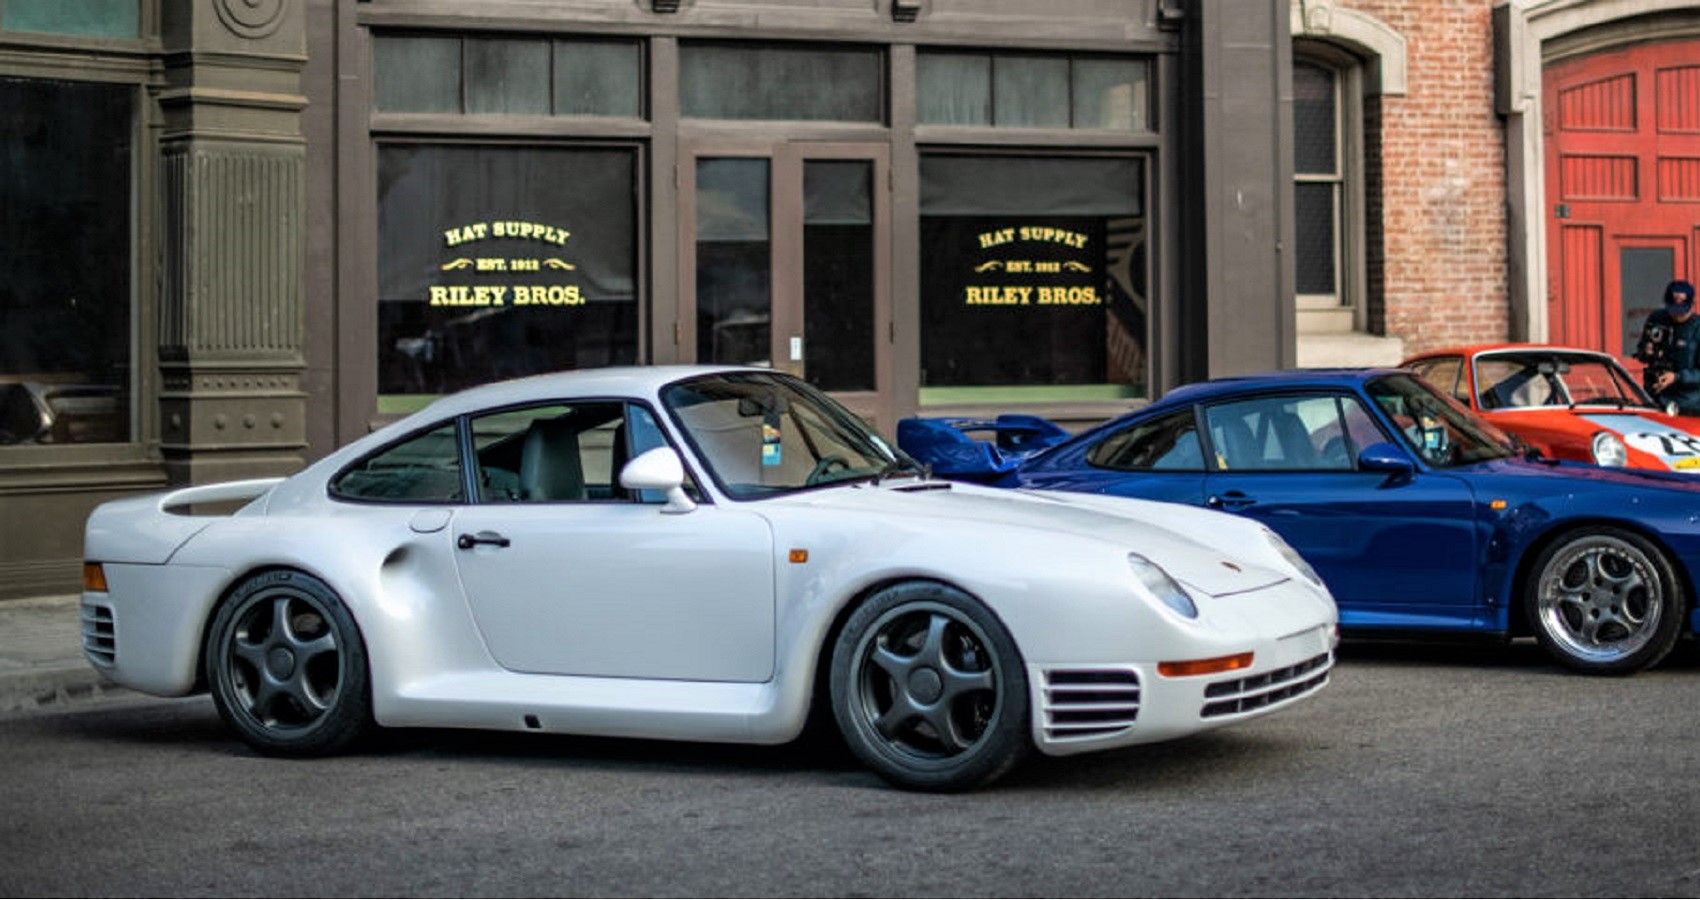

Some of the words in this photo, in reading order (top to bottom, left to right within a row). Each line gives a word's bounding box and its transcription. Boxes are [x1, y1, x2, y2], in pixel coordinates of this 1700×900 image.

[444, 223, 487, 246] HAT
[492, 220, 571, 246] SUPPLY
[978, 227, 1015, 249] HAT
[1019, 226, 1089, 249] SUPPLY
[475, 258, 508, 271] EST.
[1005, 260, 1034, 273] EST.
[429, 285, 507, 306] RILEY
[513, 285, 586, 305] BROS.
[965, 286, 1033, 305] RILEY
[1037, 286, 1102, 305] BROS.
